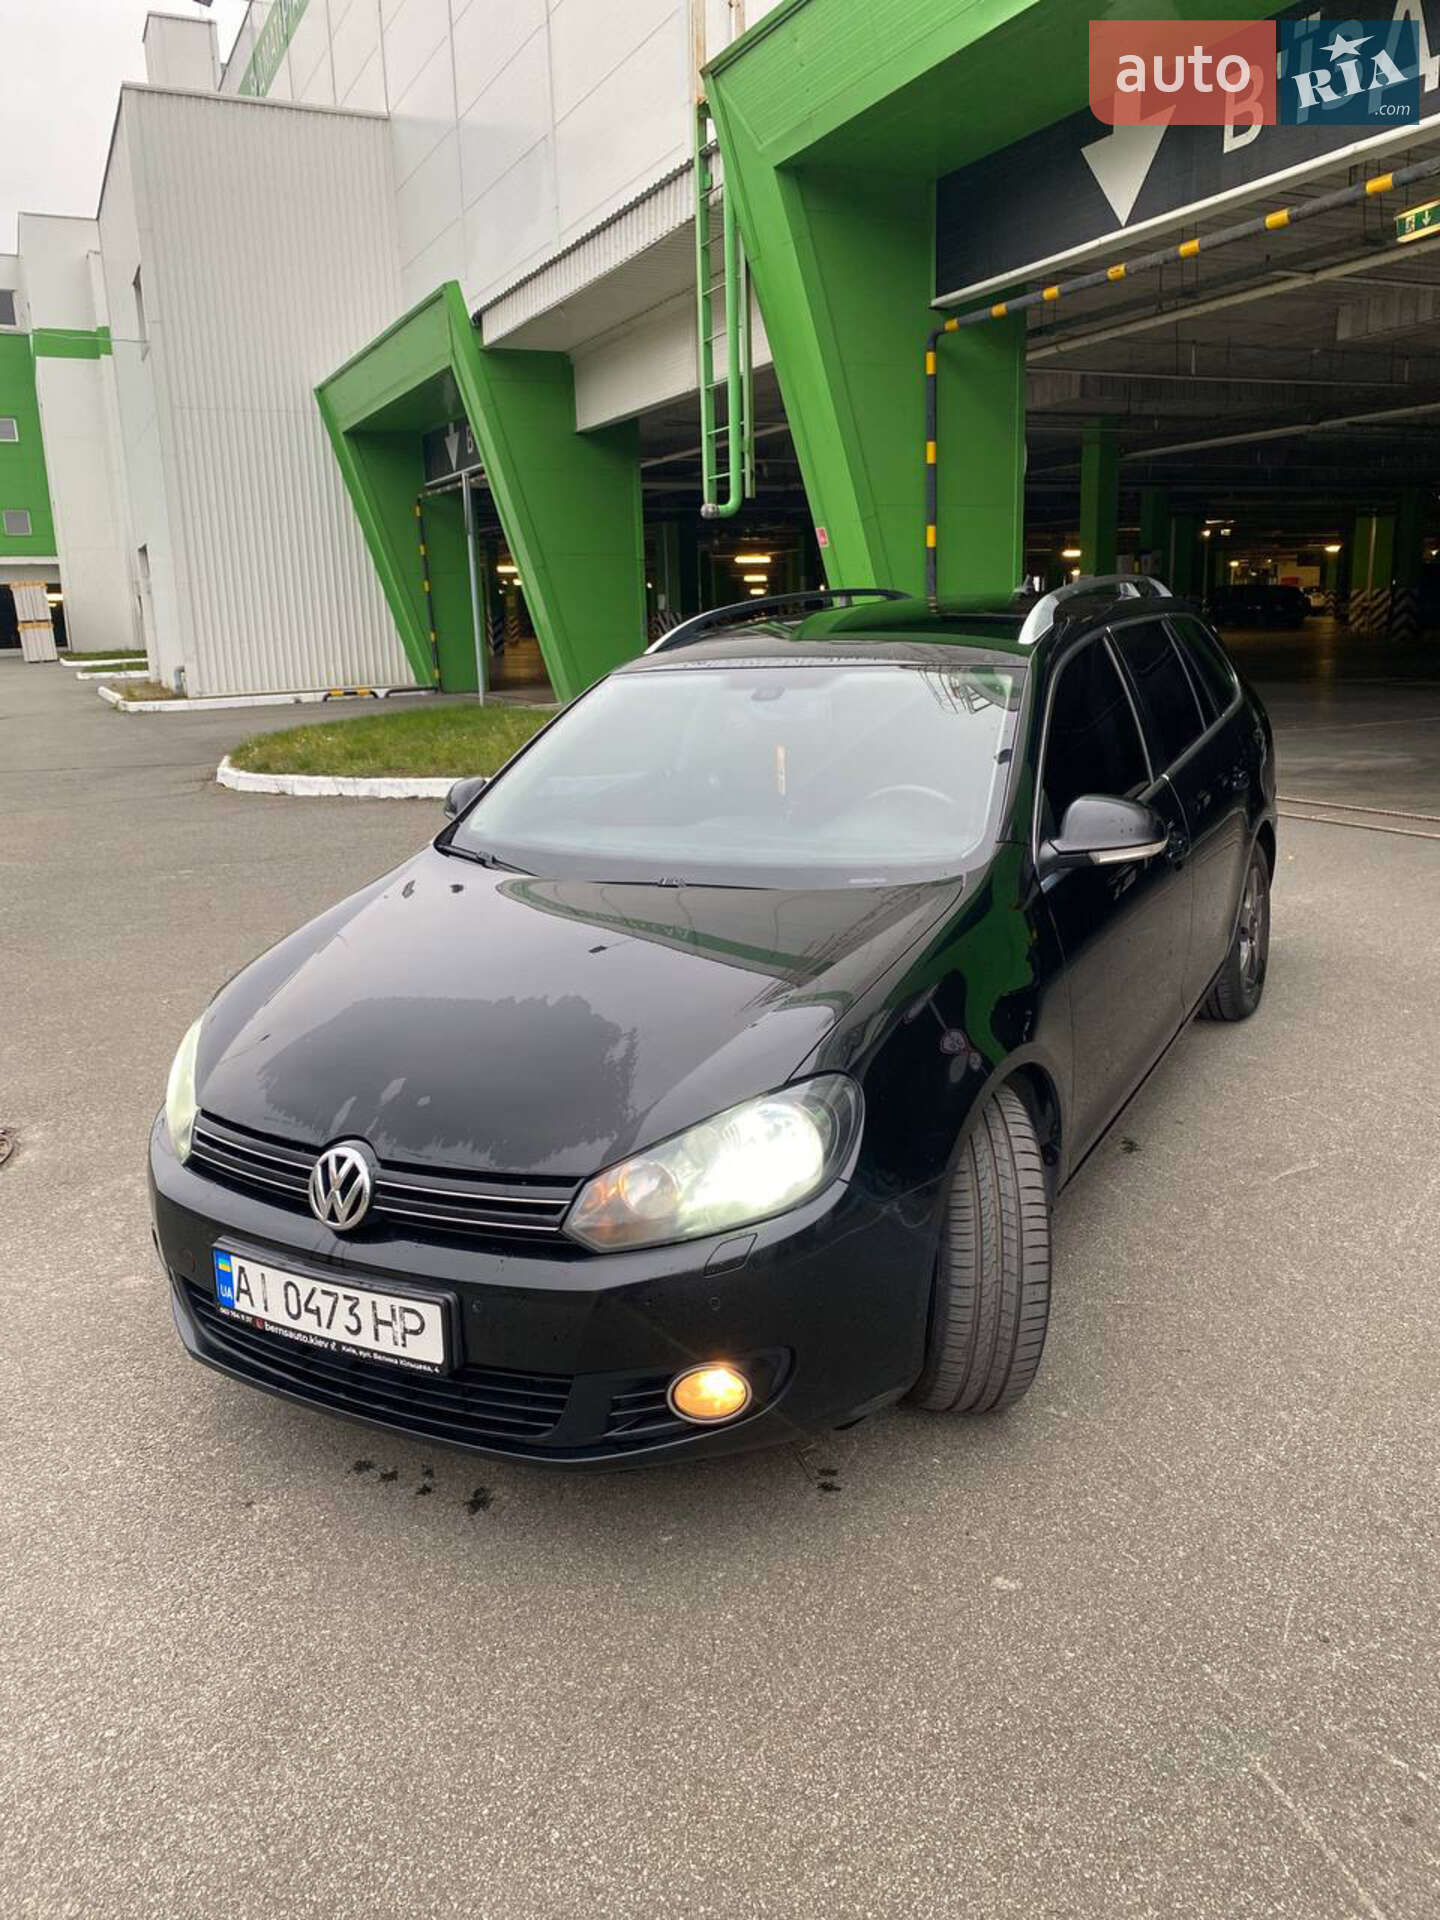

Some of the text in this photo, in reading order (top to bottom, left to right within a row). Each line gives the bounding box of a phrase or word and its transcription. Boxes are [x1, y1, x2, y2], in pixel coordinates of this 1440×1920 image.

[220, 1284, 233, 1299] UA
[283, 1280, 362, 1337] 0473
[371, 1300, 426, 1348] HP
